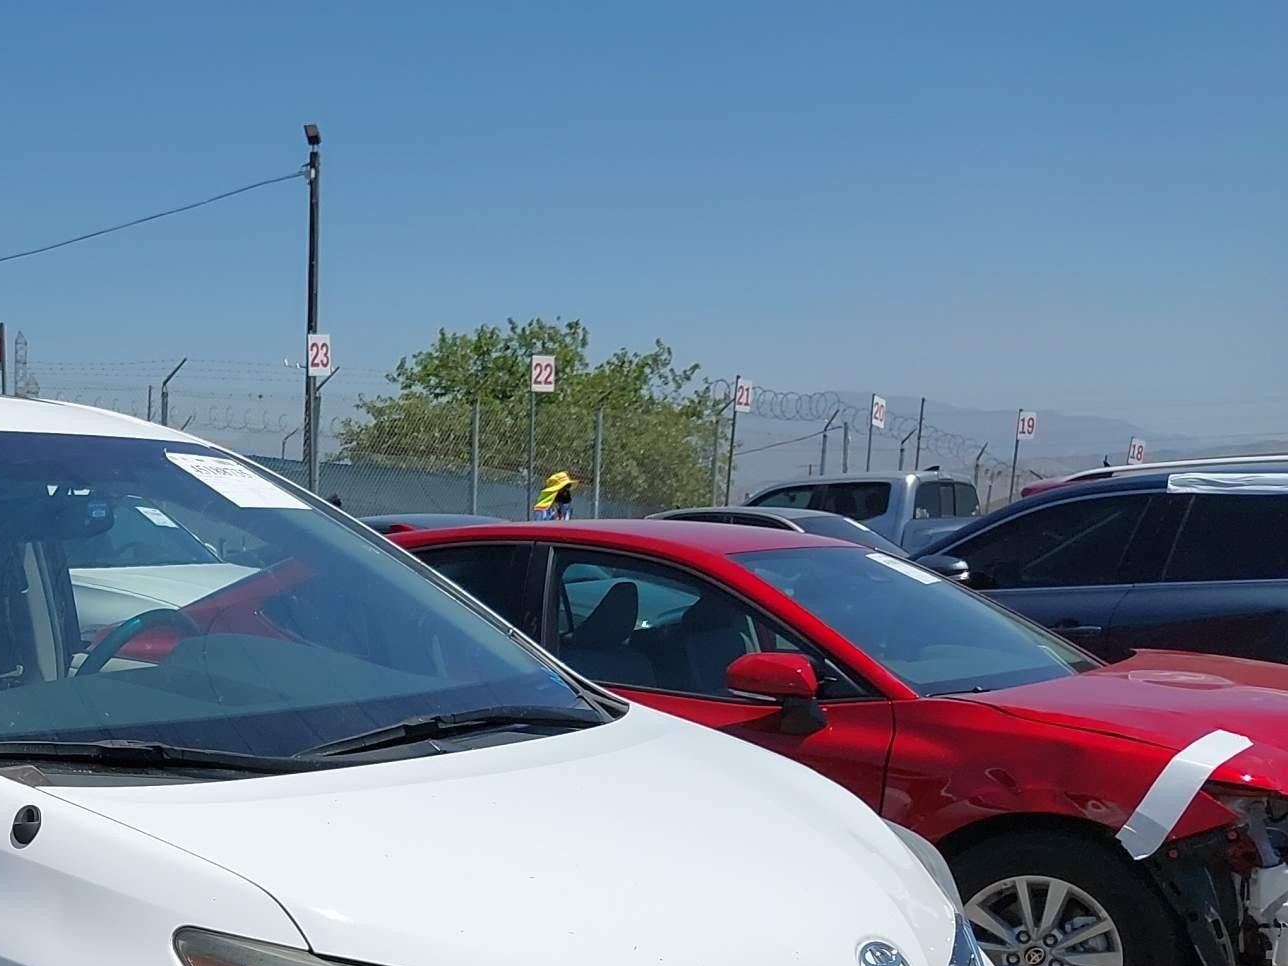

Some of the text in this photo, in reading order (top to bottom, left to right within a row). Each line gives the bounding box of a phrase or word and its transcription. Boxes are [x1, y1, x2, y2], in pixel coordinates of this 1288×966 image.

[310, 342, 329, 368] 23
[533, 363, 553, 385] 22
[737, 385, 750, 407] 21
[873, 401, 885, 422] 20
[1019, 417, 1035, 434] 19
[1130, 444, 1144, 461] 18
